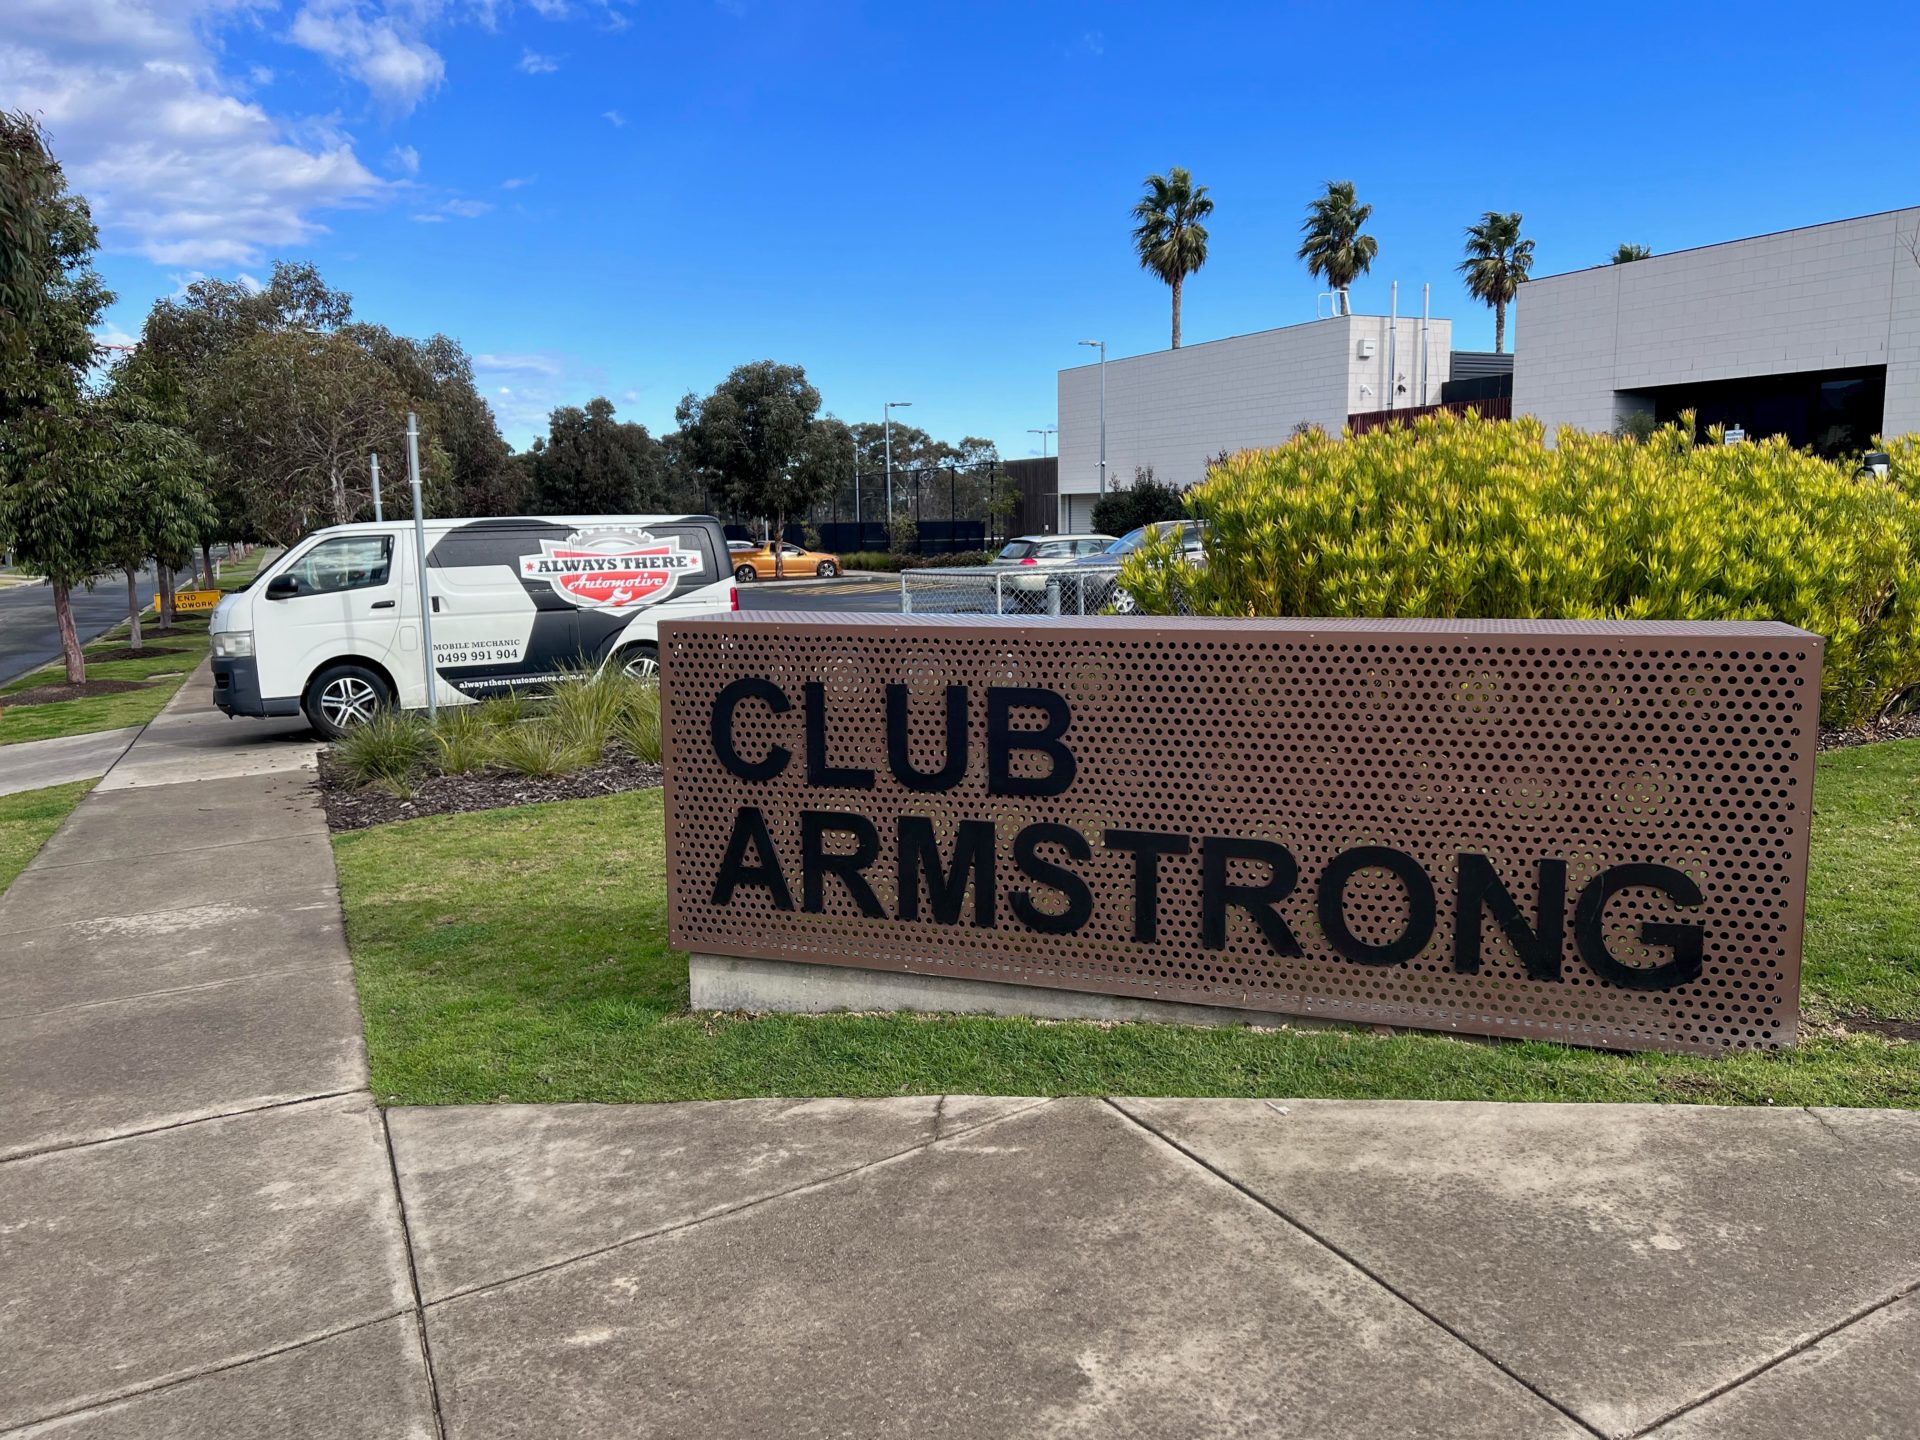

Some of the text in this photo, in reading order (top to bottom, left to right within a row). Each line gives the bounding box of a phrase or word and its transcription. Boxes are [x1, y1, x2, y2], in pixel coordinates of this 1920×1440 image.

[538, 555, 688, 573] ALWAYS THERE
[567, 572, 665, 590] Automotive
[175, 601, 214, 609] ADWORK
[177, 594, 197, 602] END
[433, 639, 521, 651] MOBILE MECHANIC
[437, 648, 518, 664] 0499 991 904
[710, 677, 1077, 797] CLUB
[710, 806, 1705, 992] ARMSTRONG
